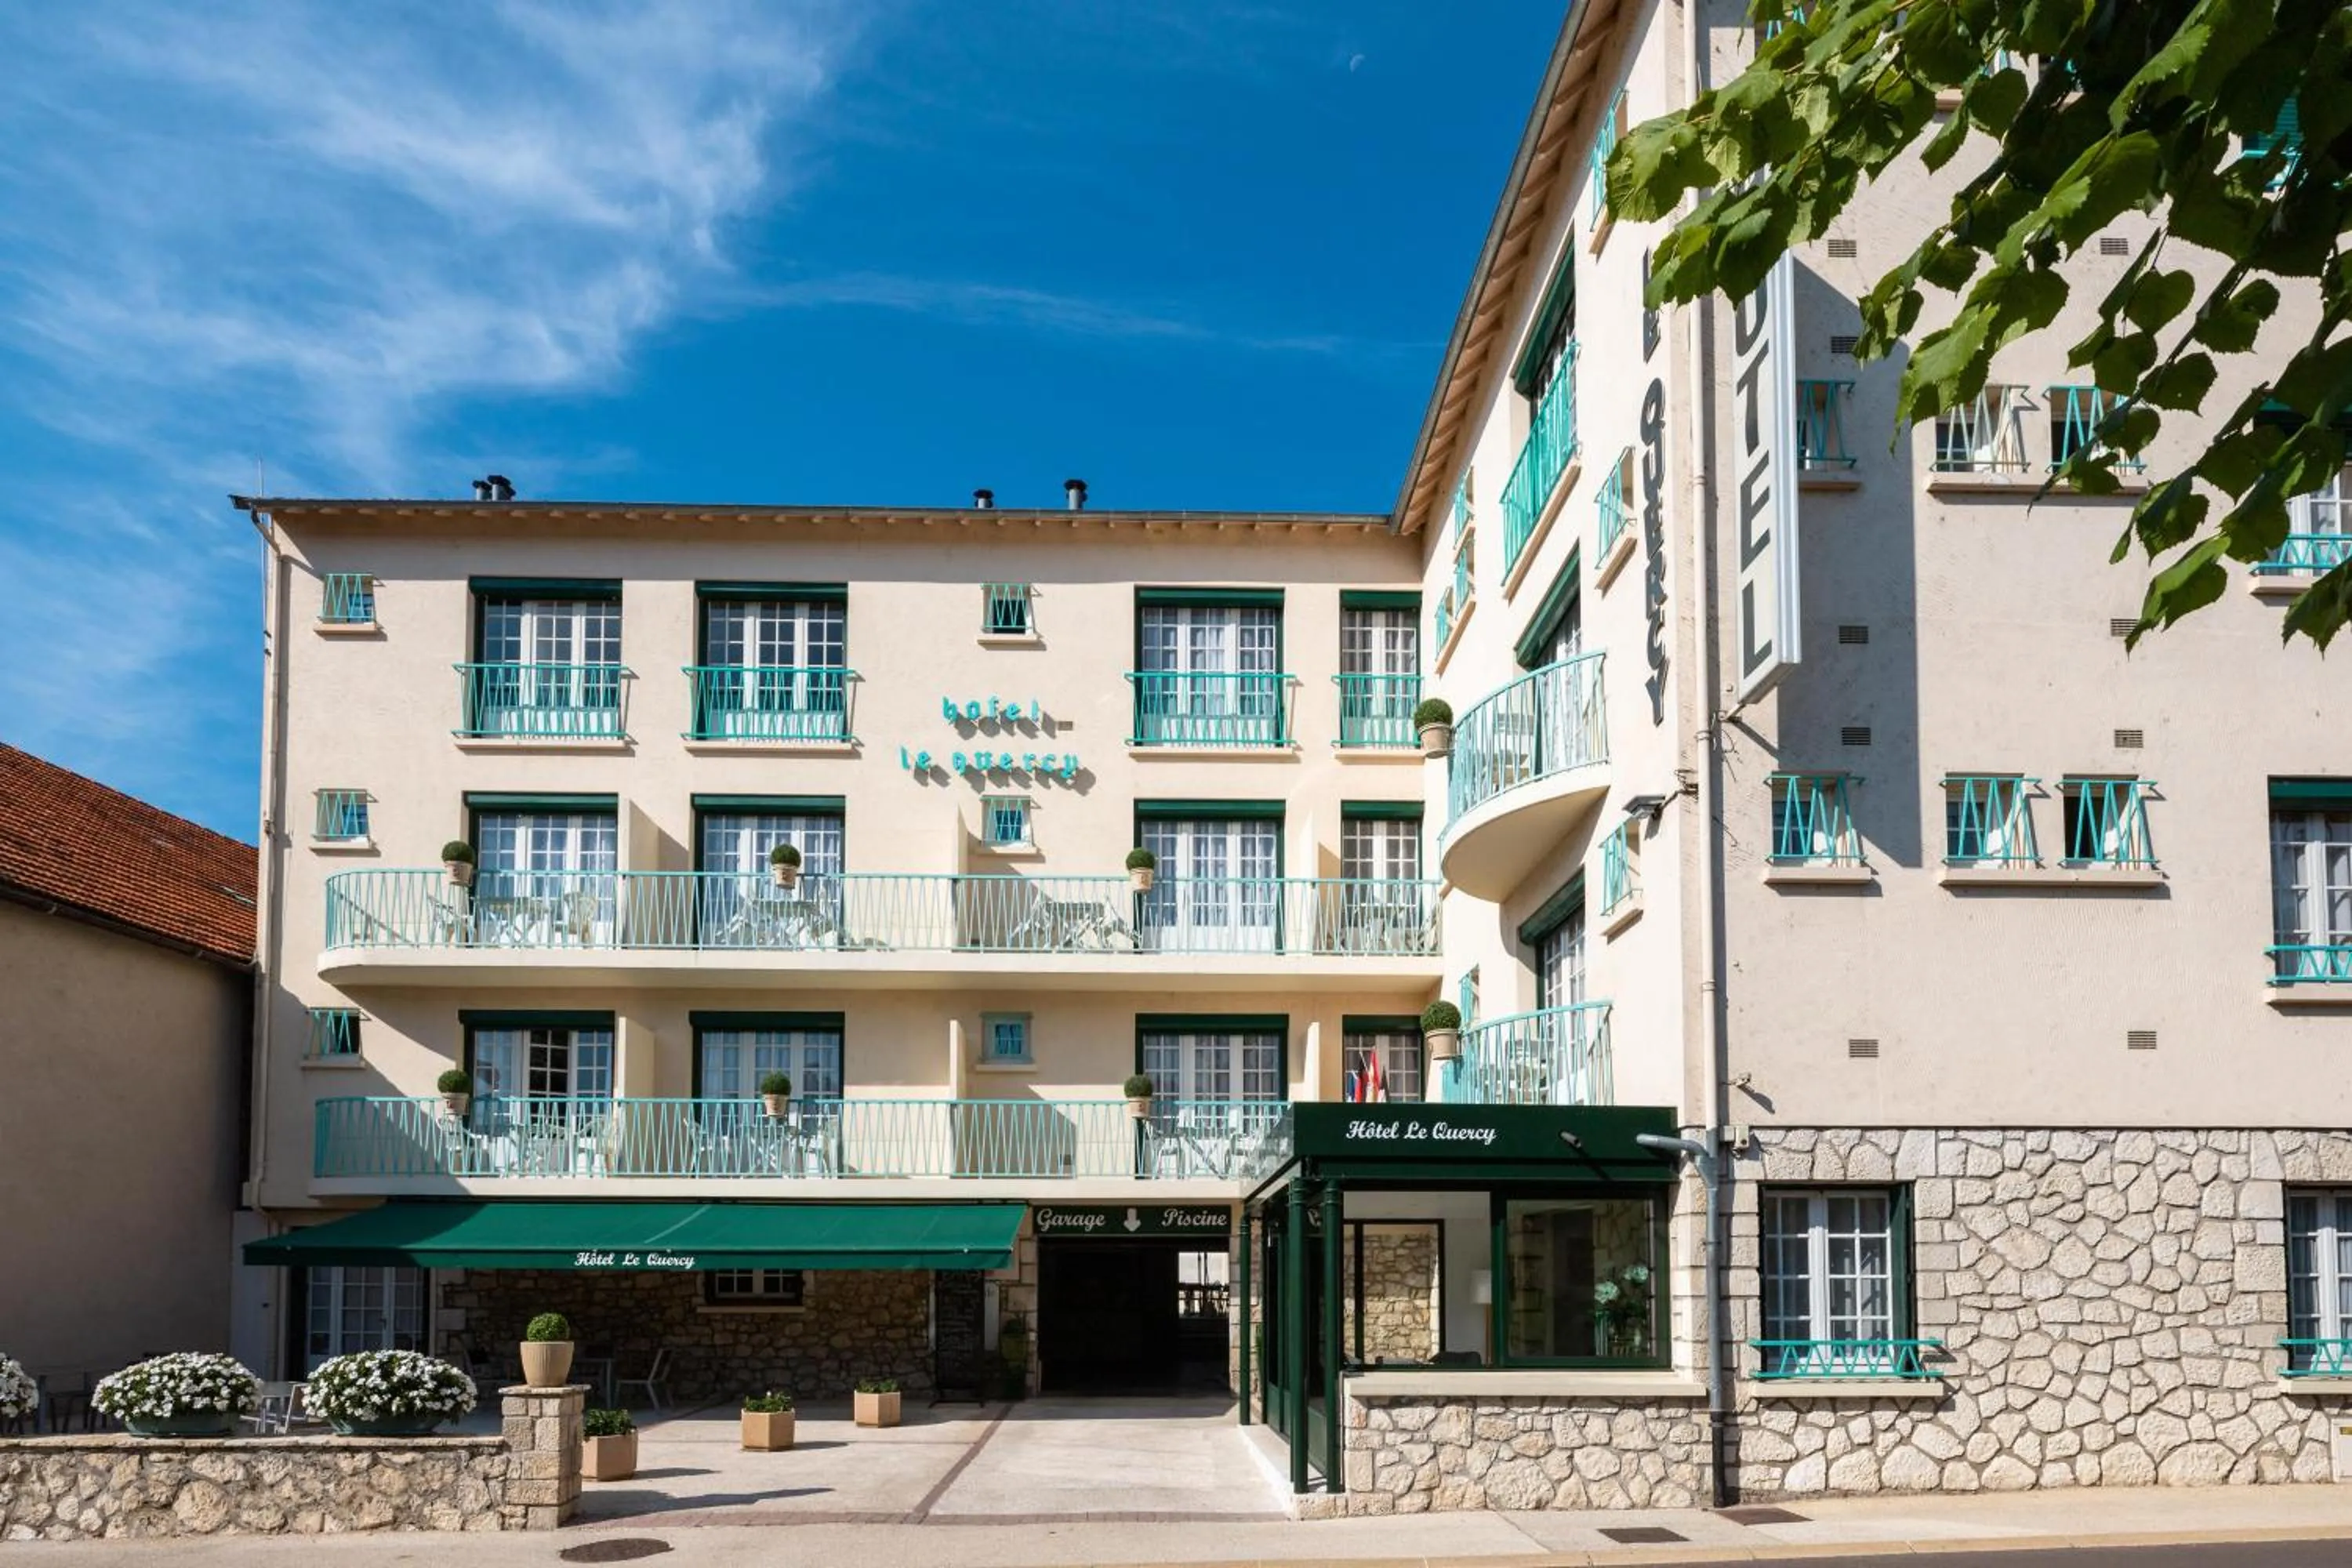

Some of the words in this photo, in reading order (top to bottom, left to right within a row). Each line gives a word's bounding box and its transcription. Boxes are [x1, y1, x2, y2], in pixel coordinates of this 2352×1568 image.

[1735, 278, 1772, 680] OTEL
[1640, 377, 1668, 727] QUERCY
[1346, 1120, 1400, 1139] Hôtel
[1403, 1120, 1428, 1139] Le
[1432, 1121, 1497, 1145] Quercy
[1036, 1207, 1105, 1232] Garage
[1161, 1208, 1229, 1227] Piscine
[574, 1248, 615, 1266] Hôtel
[622, 1252, 641, 1266] Le
[646, 1252, 695, 1270] Quercy
